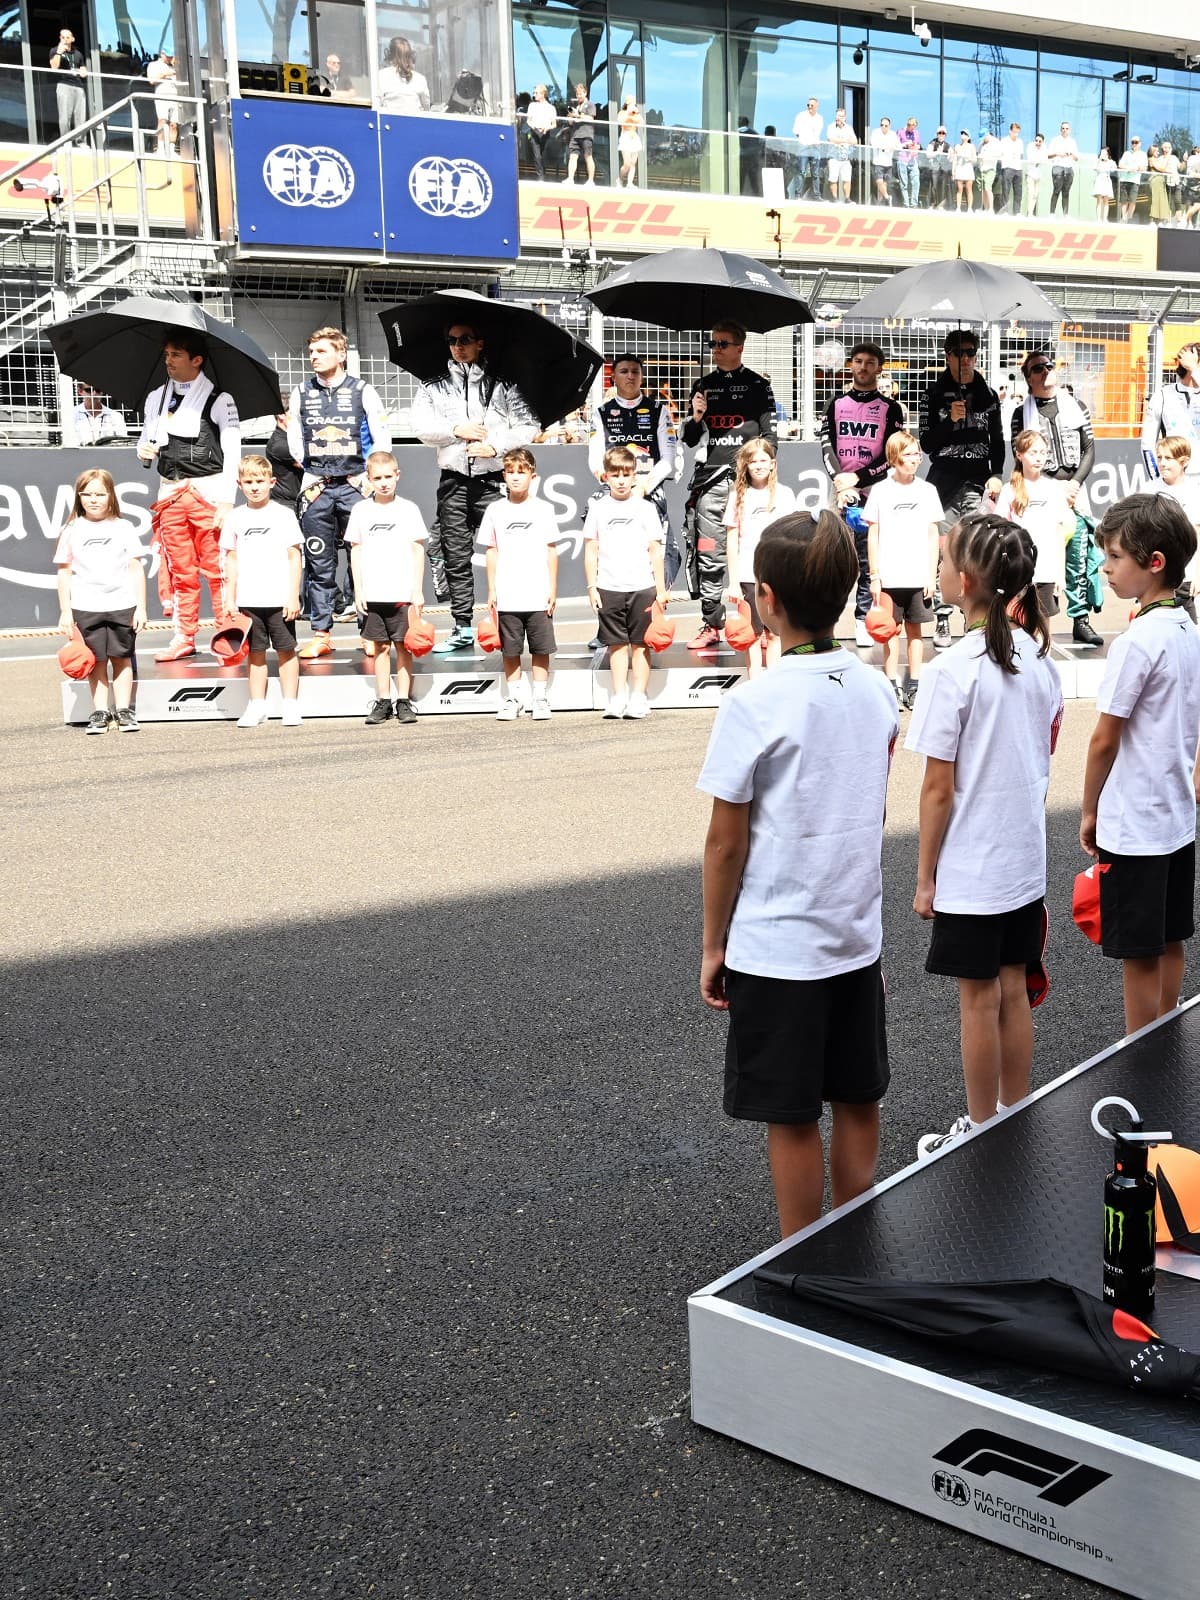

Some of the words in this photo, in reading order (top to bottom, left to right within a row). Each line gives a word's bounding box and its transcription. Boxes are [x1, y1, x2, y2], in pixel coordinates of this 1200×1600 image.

[270, 155, 347, 198] FIA
[414, 167, 486, 205] FIA
[533, 197, 684, 237] DHL
[793, 214, 920, 250] DHL
[1013, 229, 1123, 262] DHL
[305, 415, 356, 425] ORACLE
[838, 420, 879, 440] BWT
[608, 434, 654, 443] ORACLE
[838, 446, 857, 457] eni
[1090, 460, 1152, 505] aw
[933, 1473, 968, 1506] FIA
[974, 1487, 994, 1505] FIA
[996, 1497, 1049, 1526] Formula
[1049, 1516, 1057, 1530] 1
[974, 1500, 1011, 1524] World
[1012, 1515, 1104, 1560] Championship
